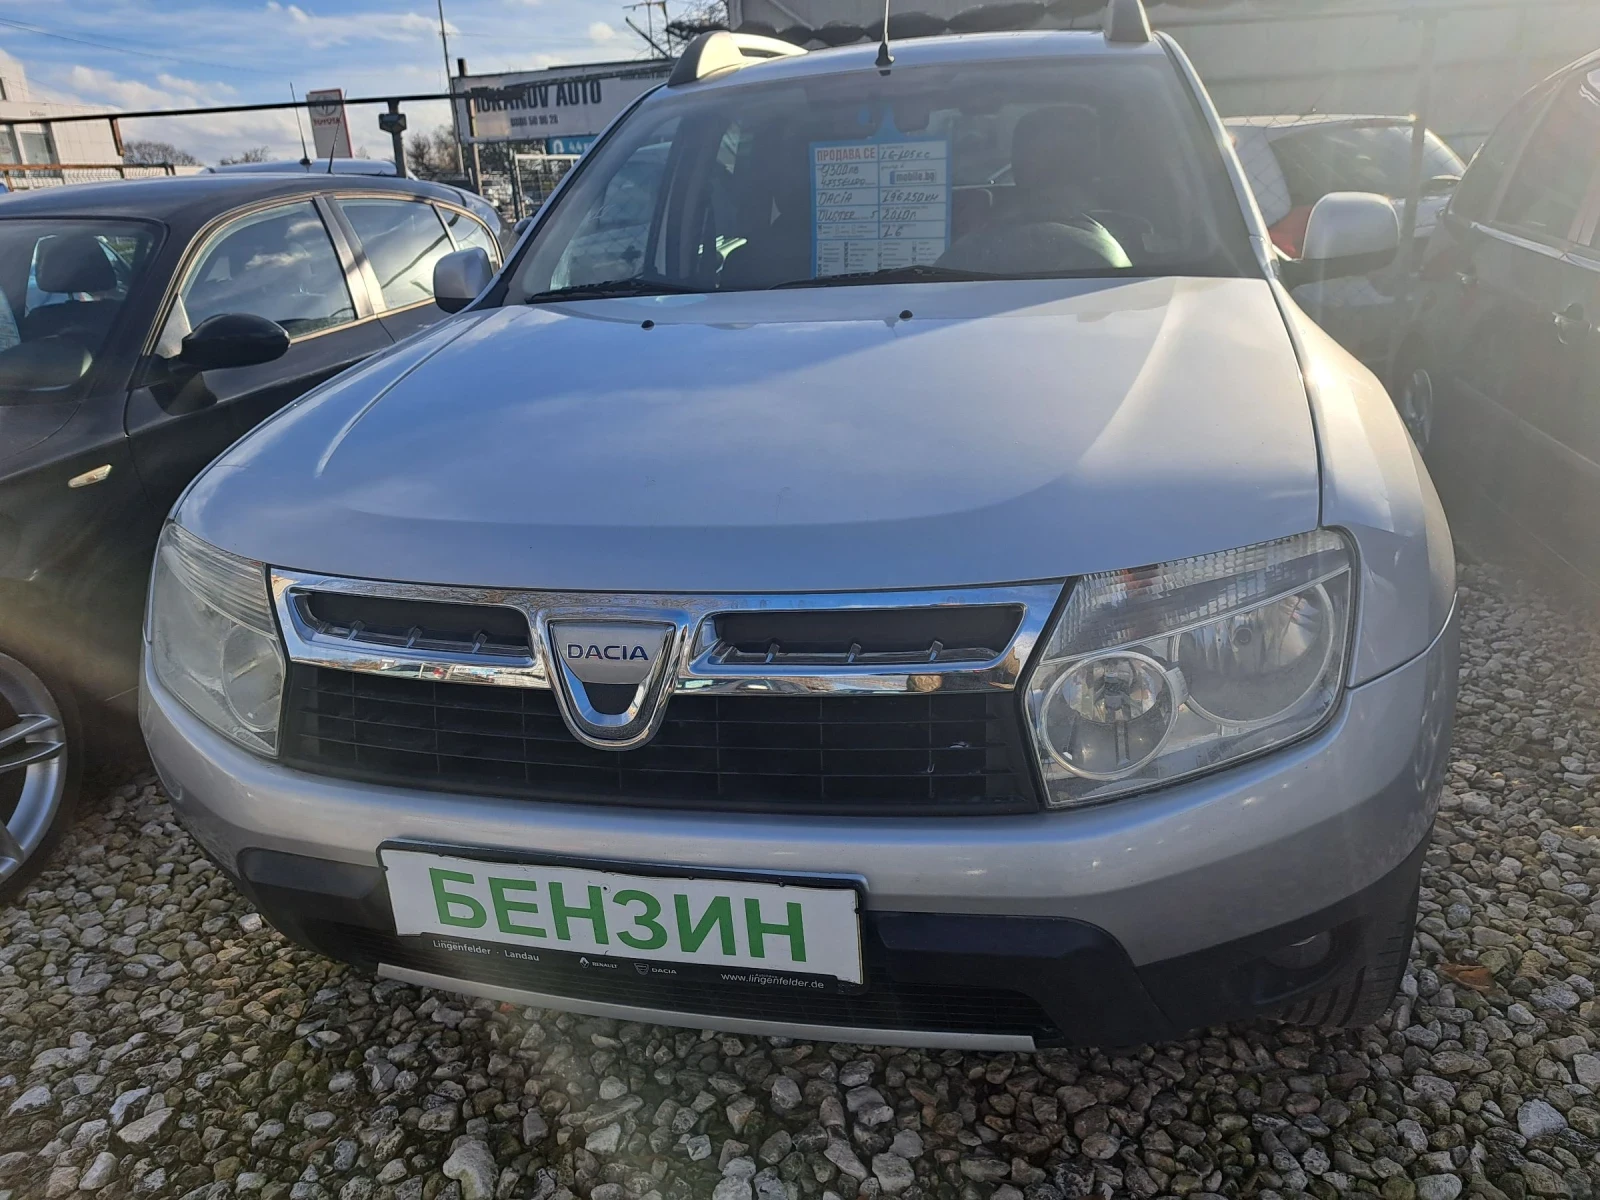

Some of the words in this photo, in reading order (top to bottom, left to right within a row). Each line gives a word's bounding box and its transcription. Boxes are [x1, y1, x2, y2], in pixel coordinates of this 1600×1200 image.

[556, 80, 602, 106] AUTO
[312, 117, 341, 126] TOYOTA
[817, 148, 861, 162] ПРОДАВА
[863, 147, 876, 159] СЕ
[896, 171, 936, 182] mobile.bg
[566, 643, 650, 661] DACIA
[428, 867, 807, 963] БЕНЗИН
[432, 940, 492, 955] Lingenfelder
[503, 949, 540, 962] Landau
[591, 961, 618, 969] RENAULT
[651, 967, 678, 975] DACIA
[720, 973, 825, 989] www.lingenfelder.de
